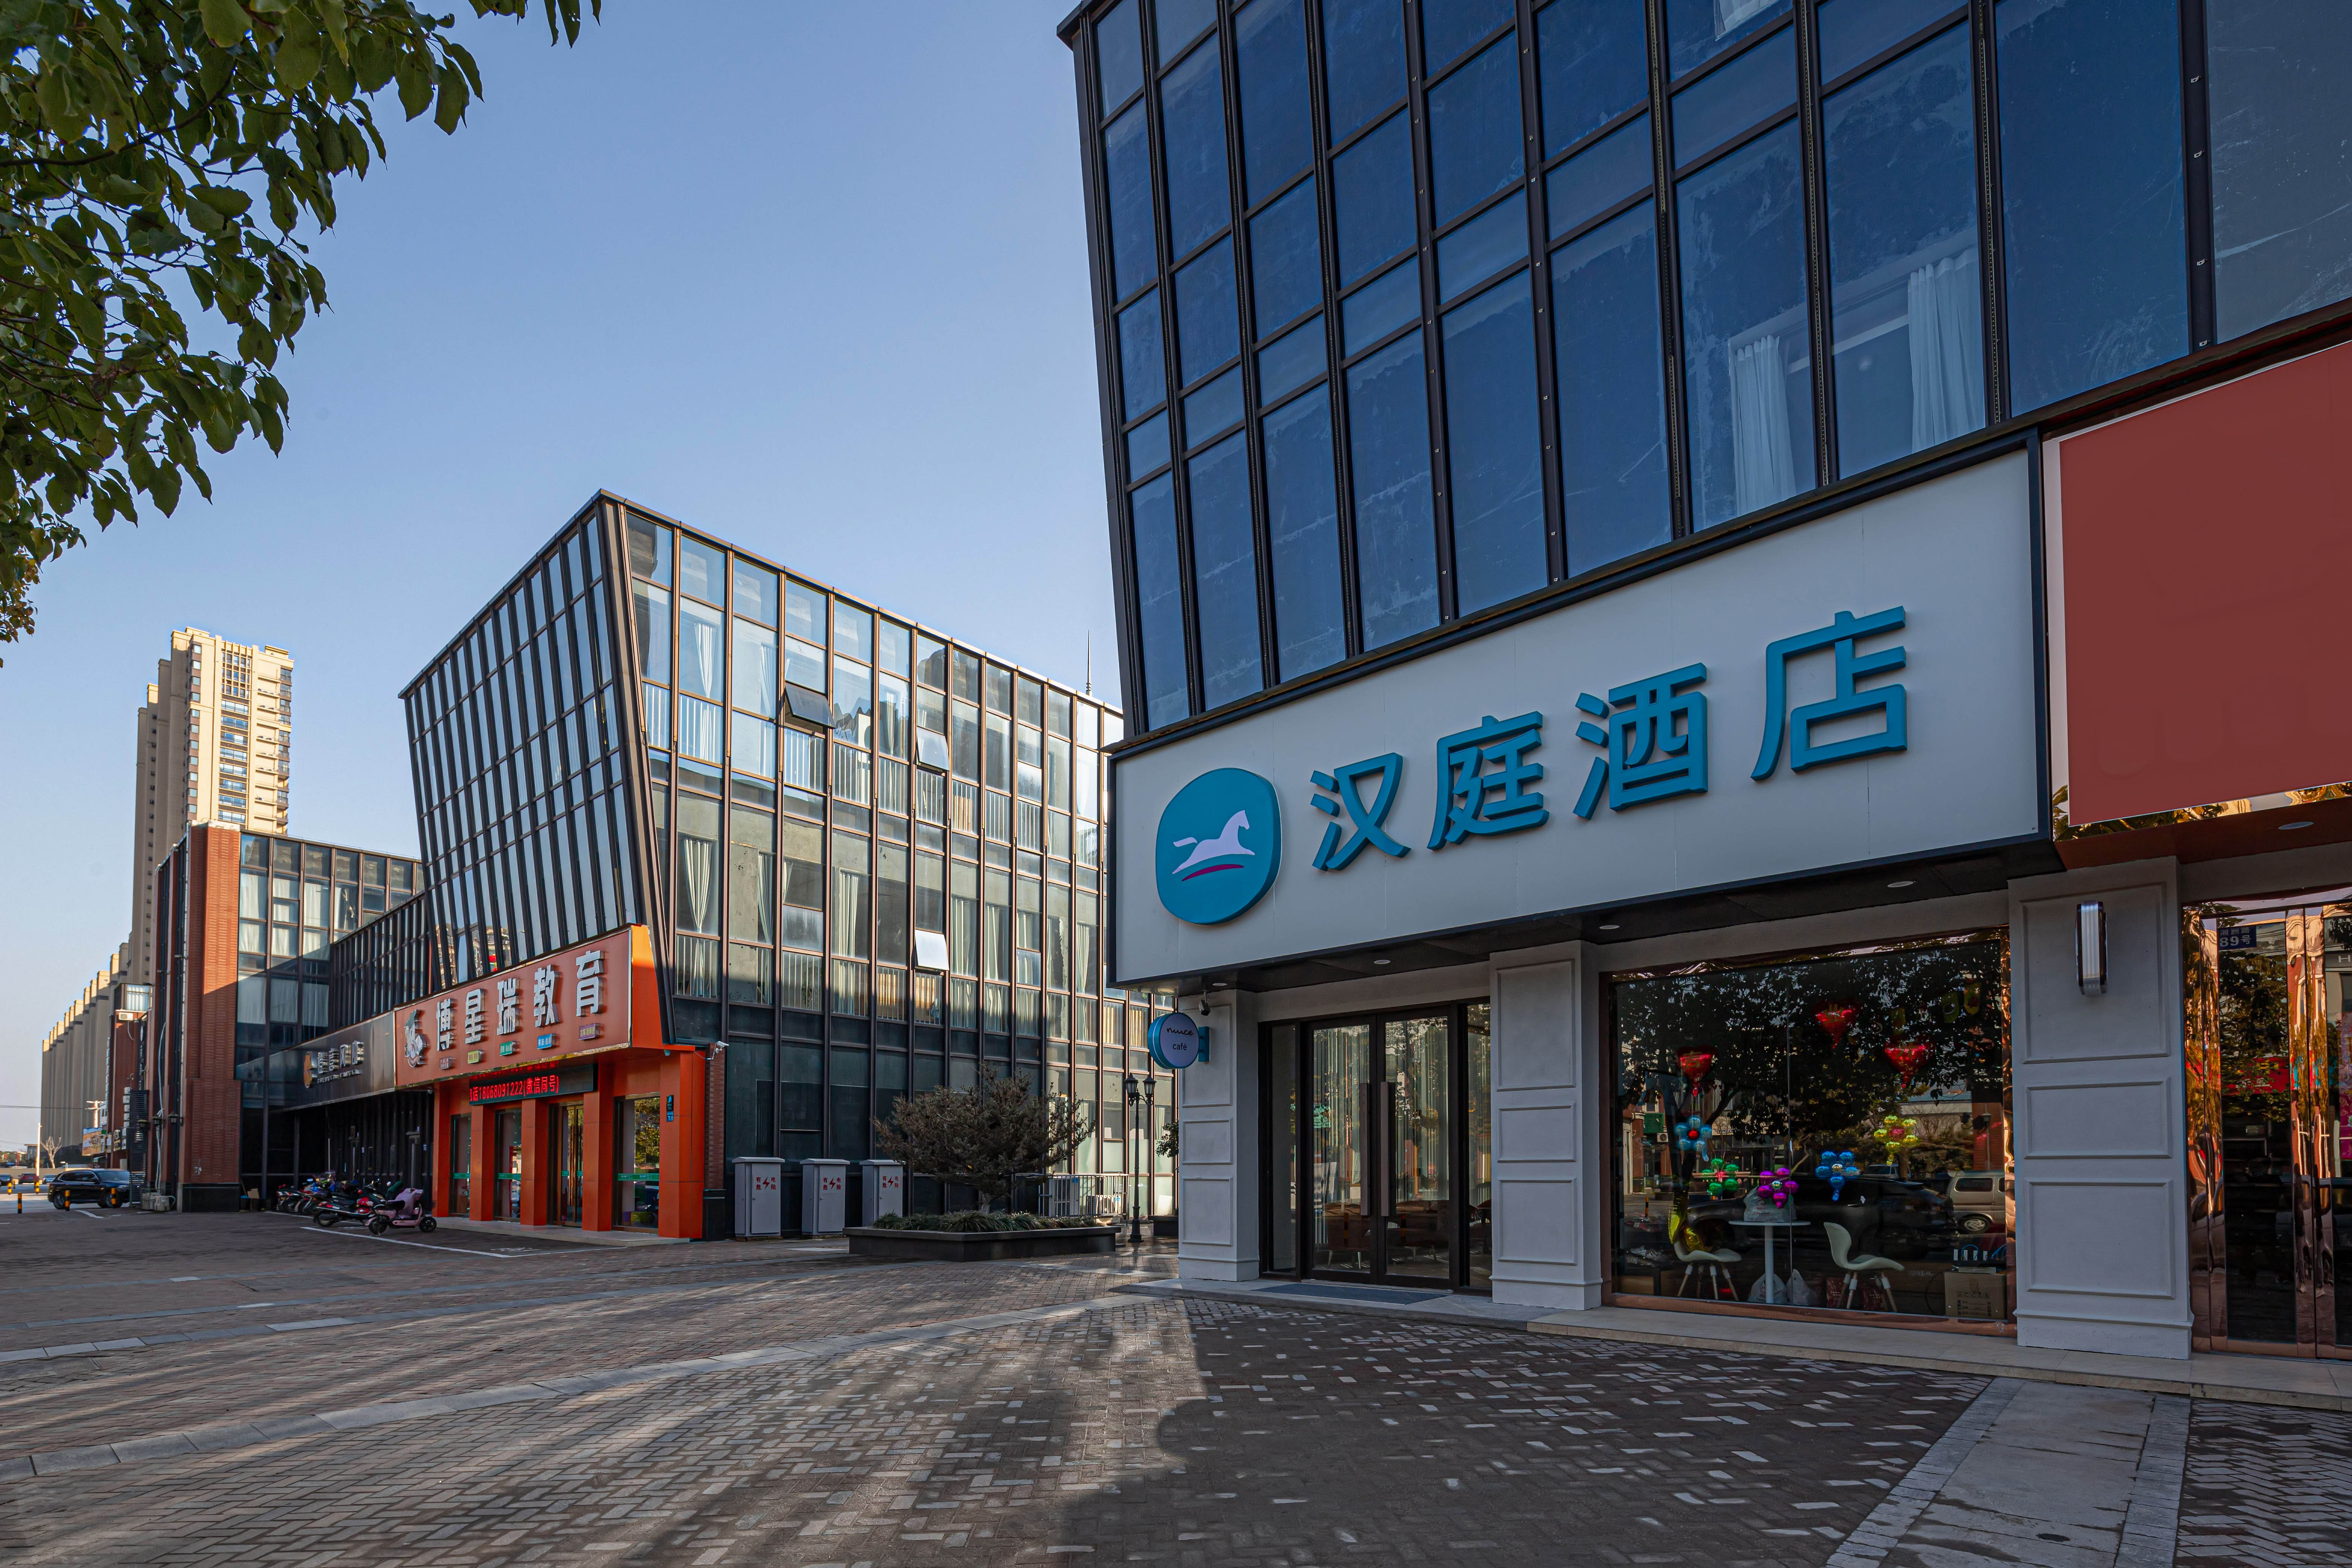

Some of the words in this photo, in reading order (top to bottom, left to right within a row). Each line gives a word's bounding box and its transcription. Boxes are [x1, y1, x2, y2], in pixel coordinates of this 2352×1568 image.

[1309, 606, 1908, 871] 汉庭酒店
[2219, 934, 2252, 947] 89号
[436, 950, 604, 1051] 博星瑞教育
